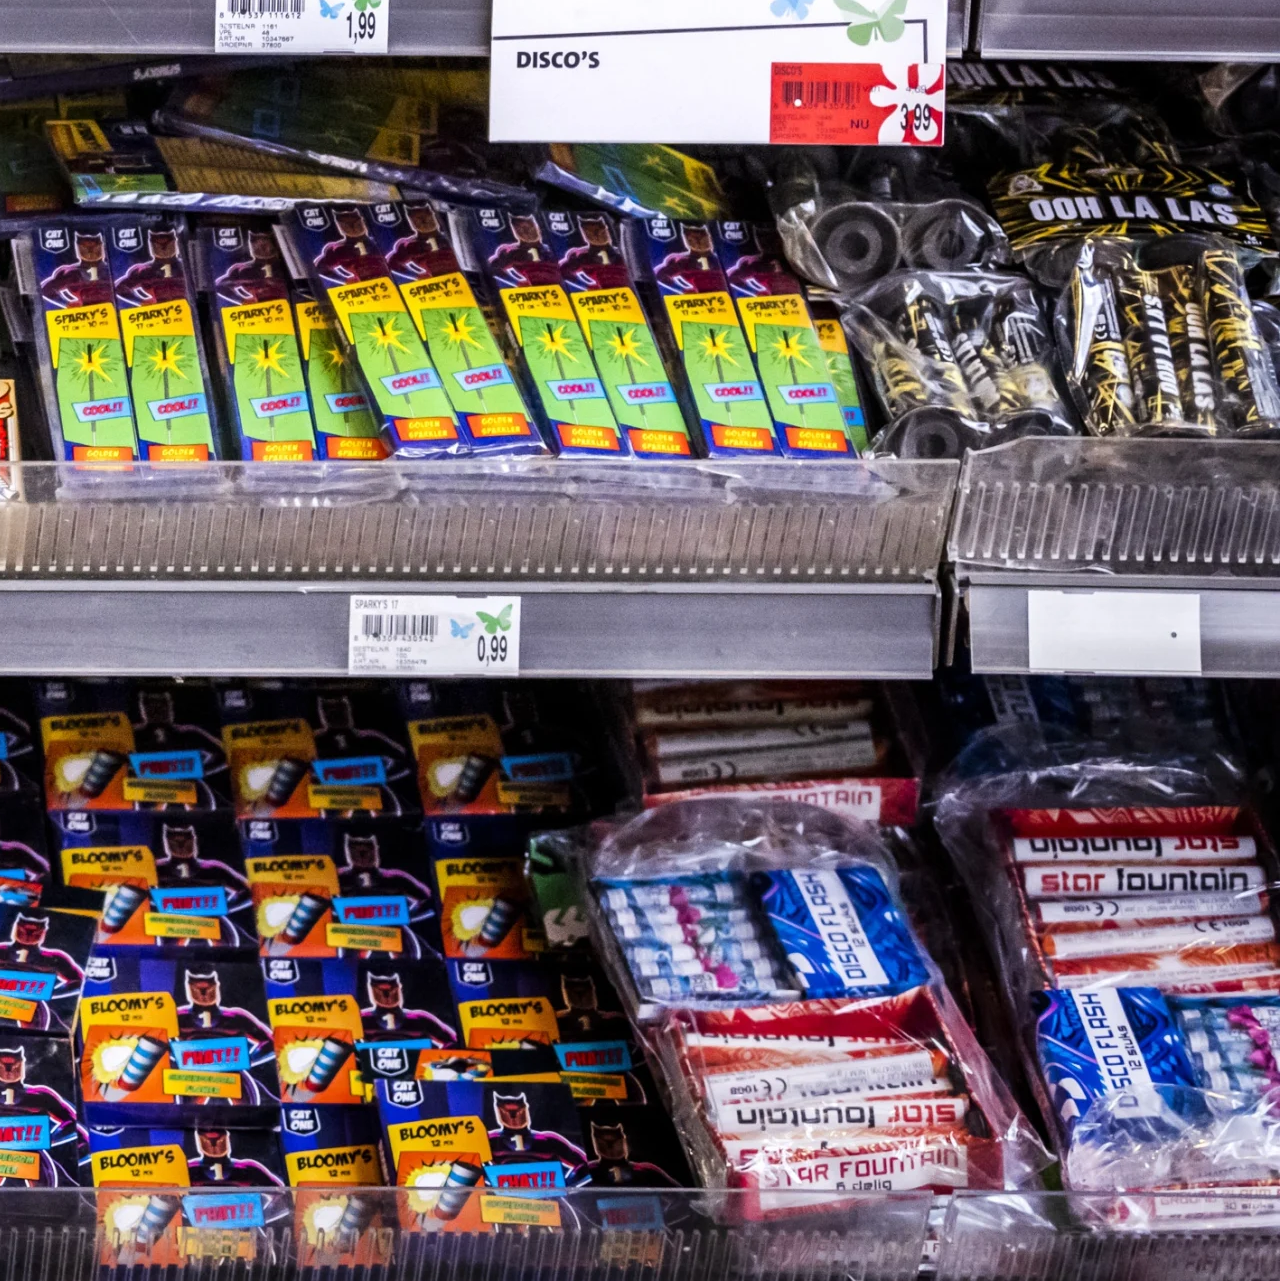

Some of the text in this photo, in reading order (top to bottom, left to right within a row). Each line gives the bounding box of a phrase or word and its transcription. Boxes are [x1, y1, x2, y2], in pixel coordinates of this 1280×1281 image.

[346, 12, 376, 44] 1,99
[516, 49, 600, 69] DISCO'S
[774, 66, 803, 76] DISCO'S
[850, 119, 870, 129] NU
[900, 103, 931, 136] 3,99
[1029, 197, 1239, 225] OOH LA LA'S
[508, 287, 559, 304] SPARKY'S
[54, 310, 108, 326] SPARKY'S
[355, 600, 399, 610] SPARKY'S 17
[477, 635, 508, 666] 0,99
[1041, 867, 1248, 892] star fountain
[91, 998, 165, 1013] BLOOMY'S
[736, 1103, 957, 1131] star fountain
[840, 1147, 960, 1178] FOUNTAIN
